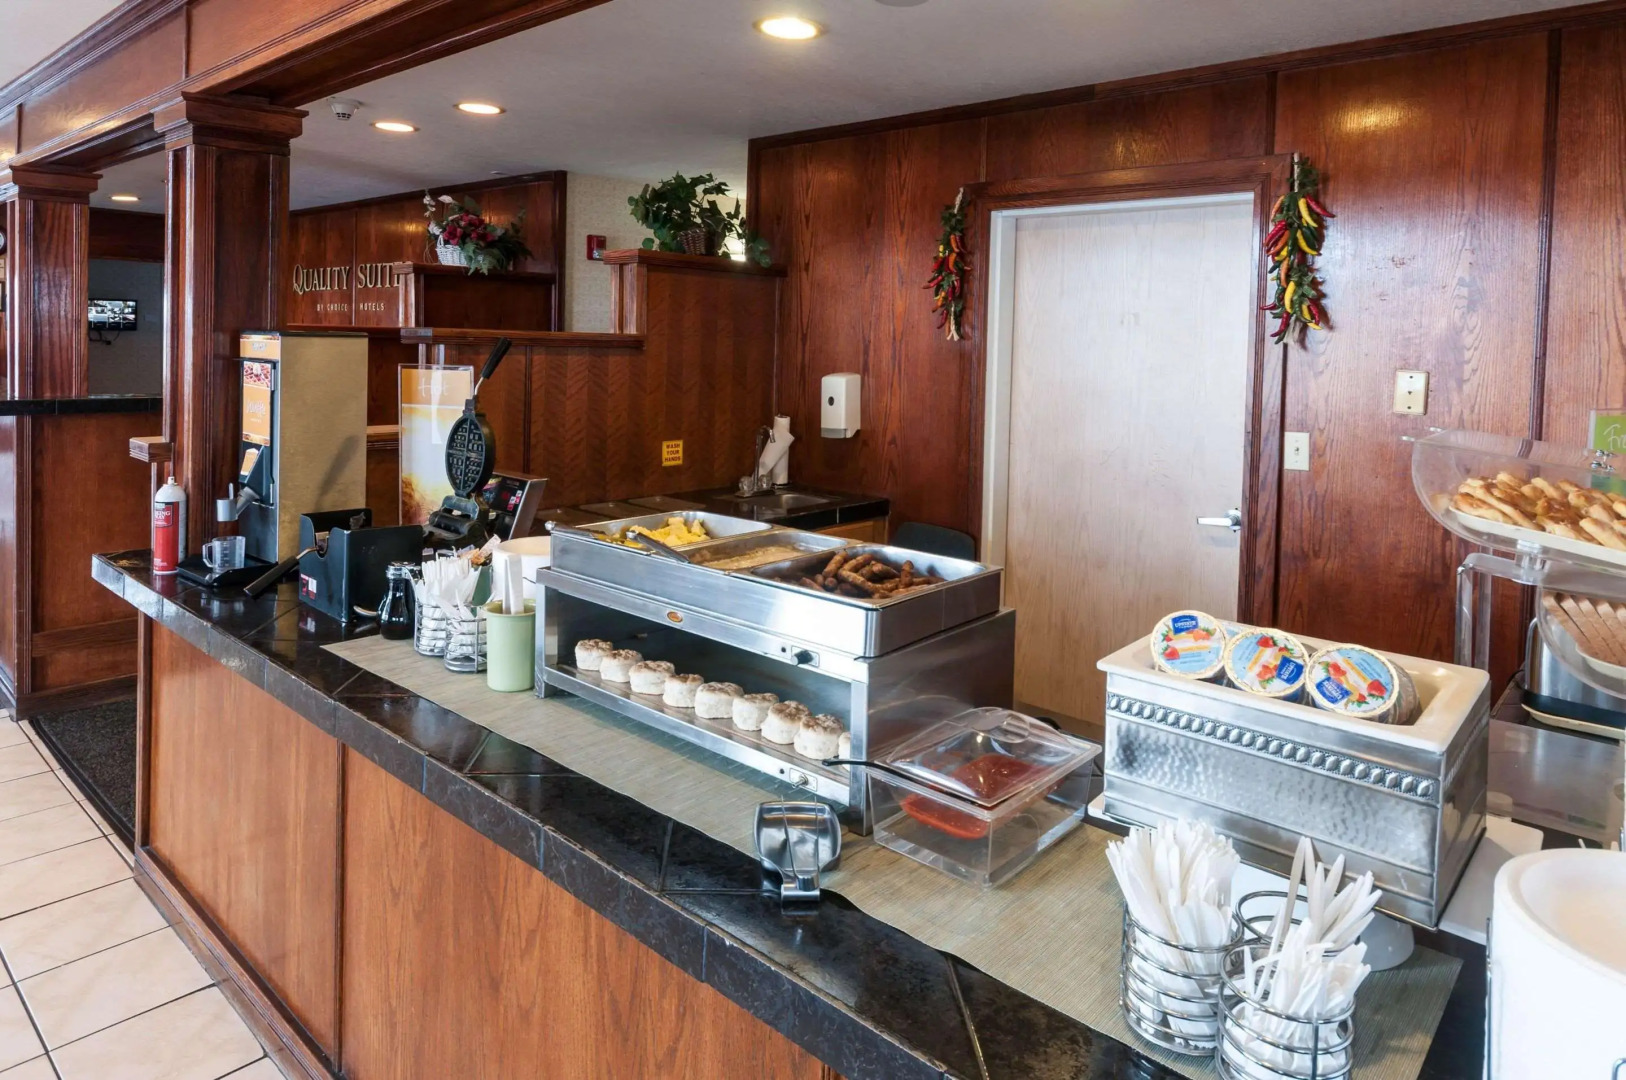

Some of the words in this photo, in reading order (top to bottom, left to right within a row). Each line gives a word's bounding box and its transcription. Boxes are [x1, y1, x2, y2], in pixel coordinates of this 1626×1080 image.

[293, 264, 350, 295] QUALITY
[316, 303, 324, 311] BY
[327, 303, 348, 311] CHOICE
[359, 302, 385, 311] HOTELS
